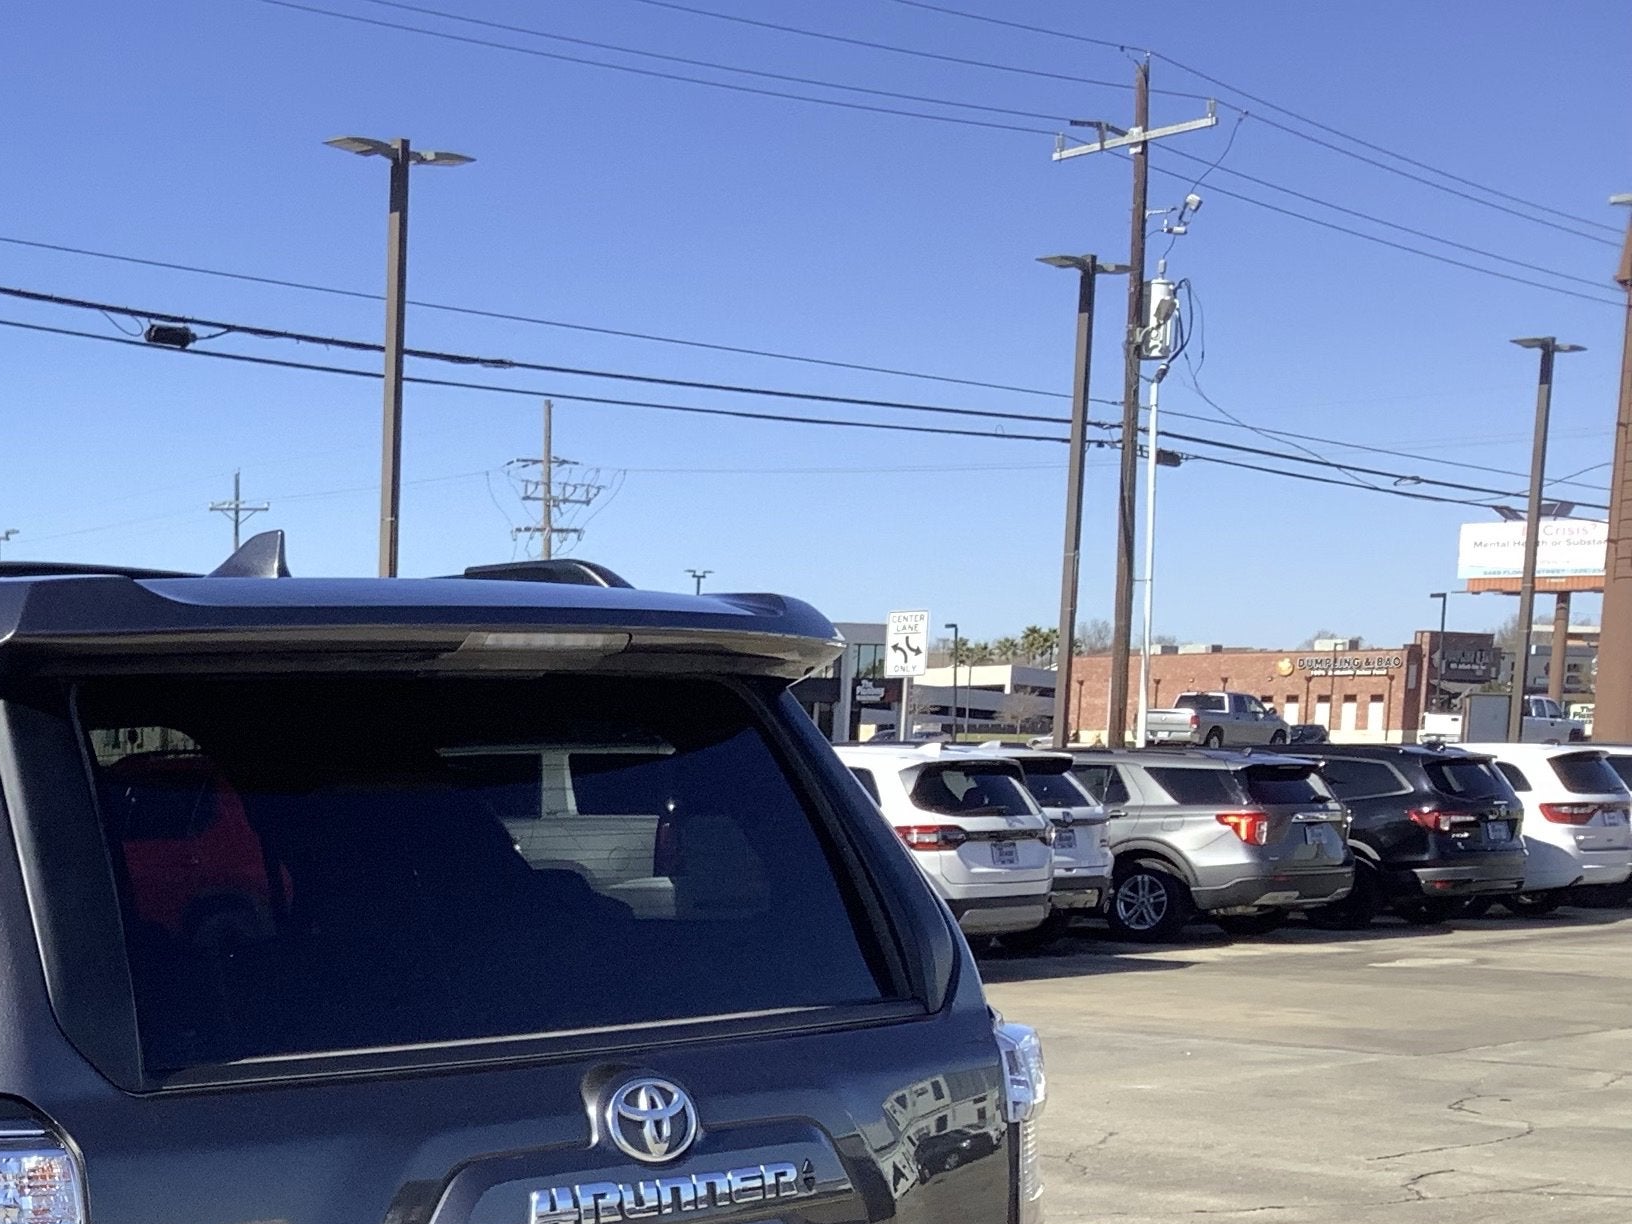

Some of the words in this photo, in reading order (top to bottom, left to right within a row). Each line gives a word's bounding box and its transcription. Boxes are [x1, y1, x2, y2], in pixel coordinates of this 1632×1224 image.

[1473, 539, 1509, 549] Mental
[892, 613, 925, 623] CENTER
[896, 624, 919, 633] LANE
[1297, 657, 1361, 670] DUMPLING
[1364, 657, 1376, 668] &
[1376, 656, 1403, 668] BAO
[893, 664, 917, 673] ONLY
